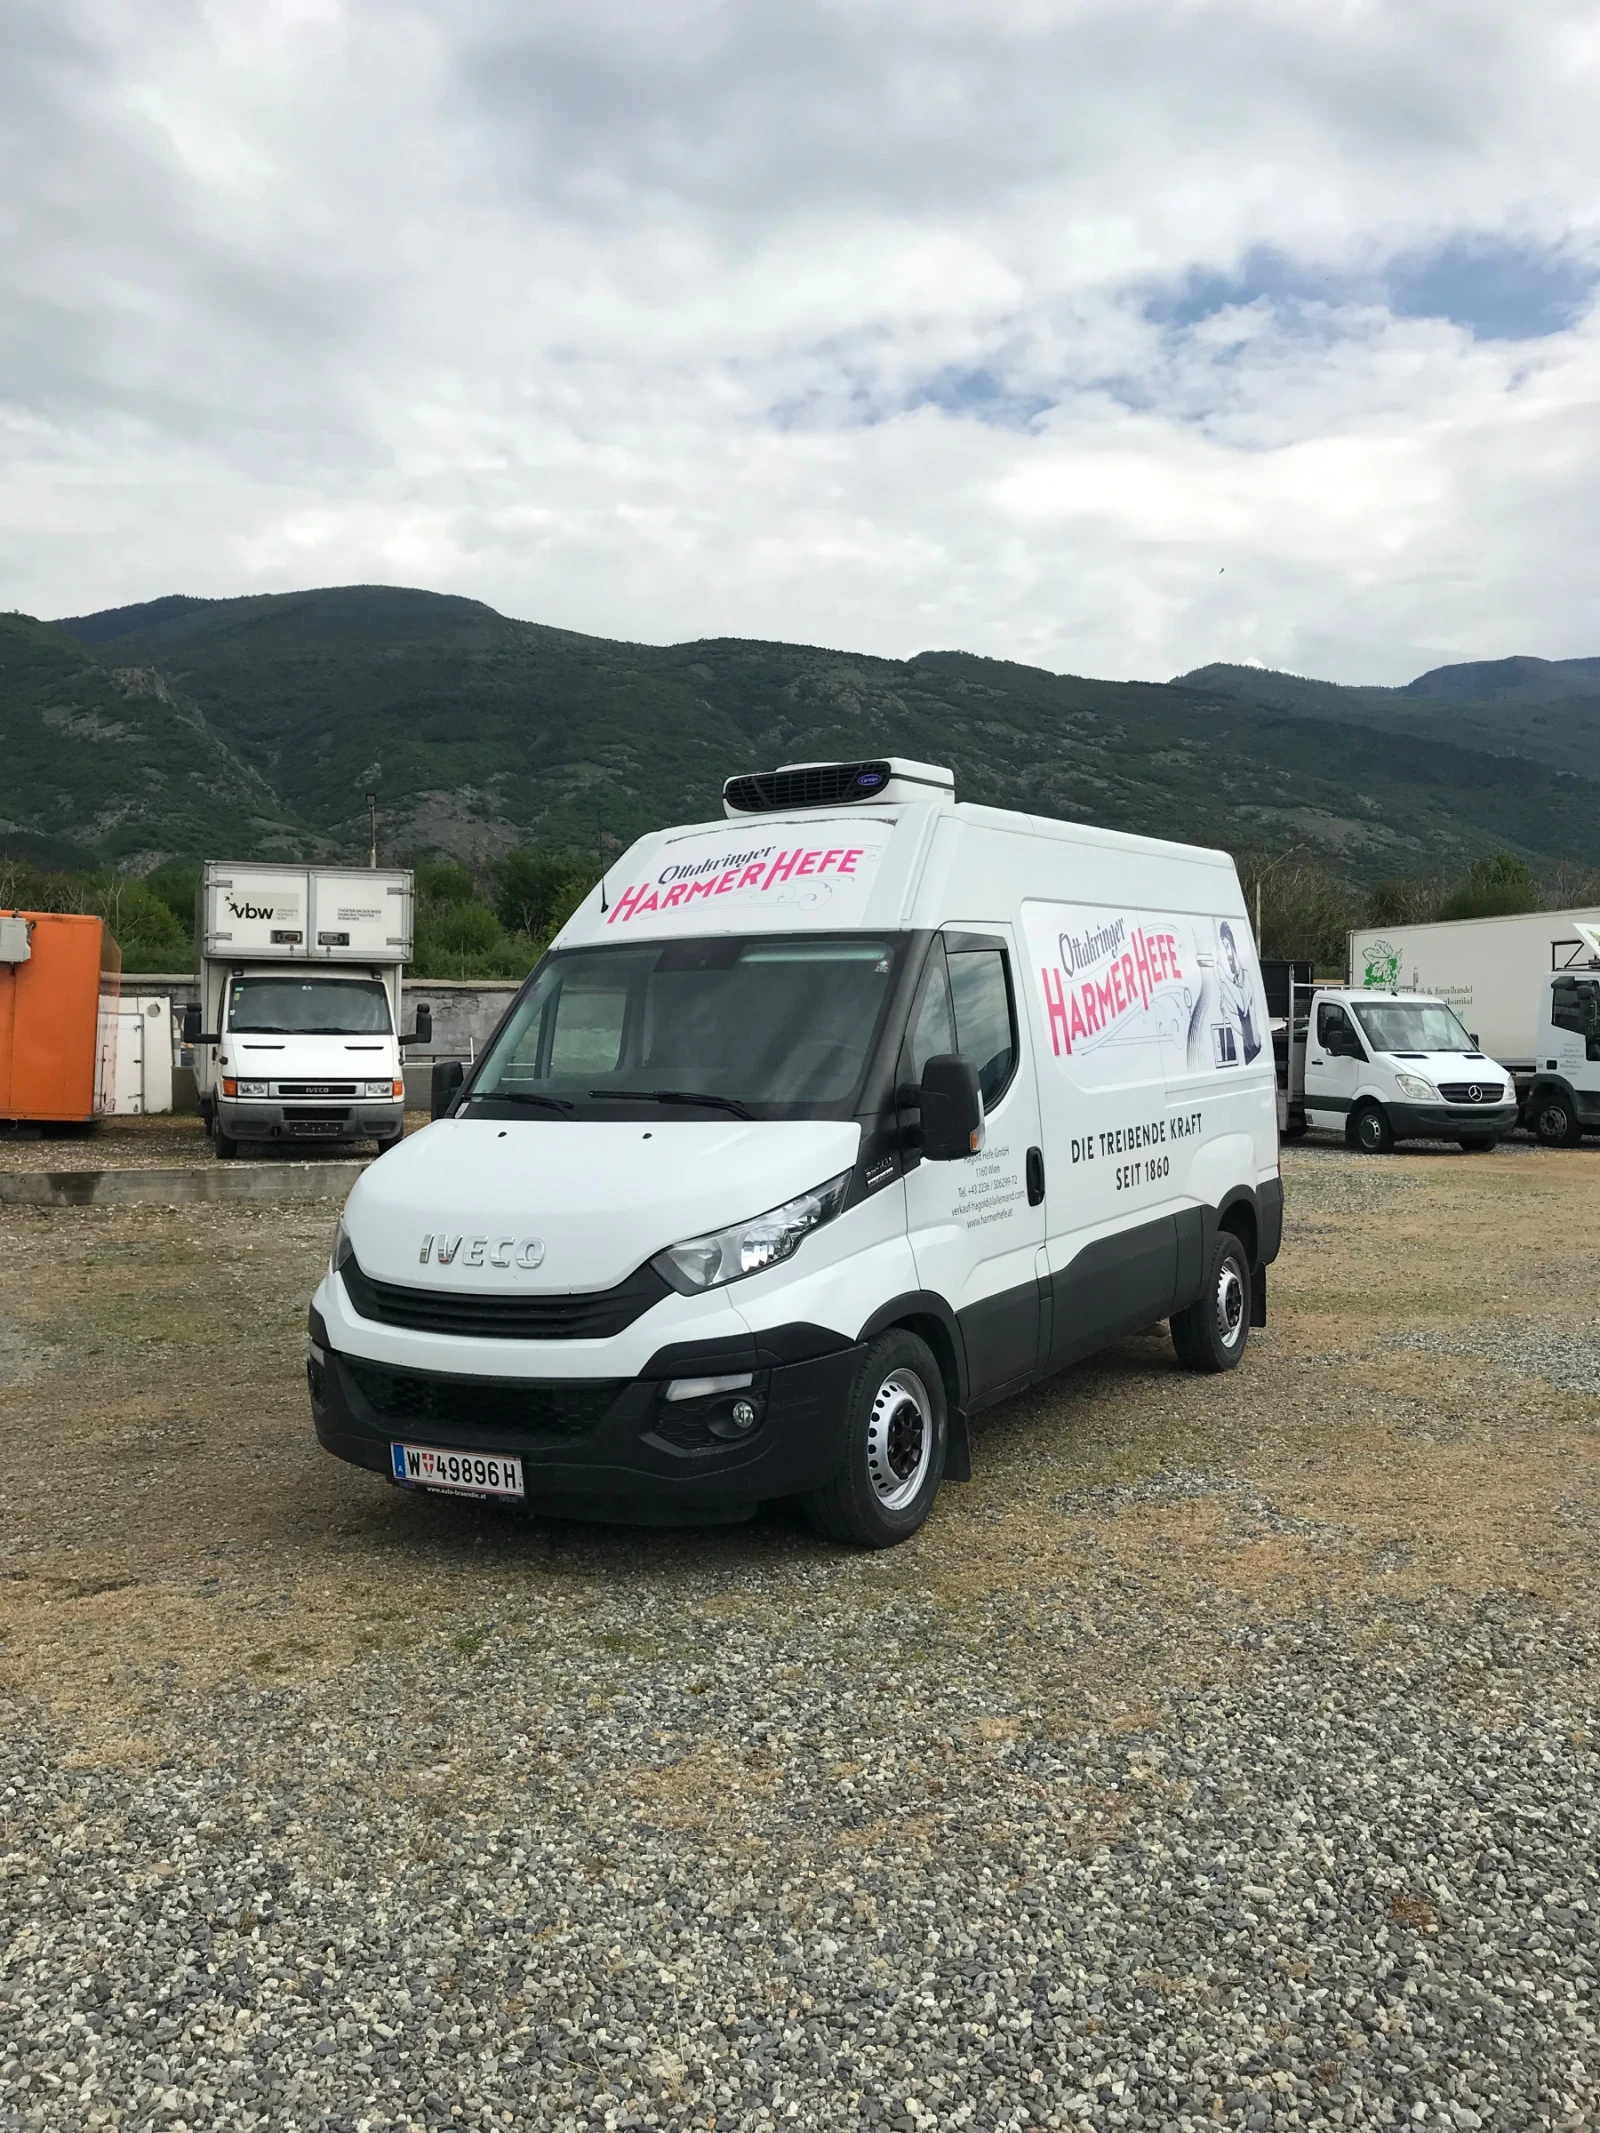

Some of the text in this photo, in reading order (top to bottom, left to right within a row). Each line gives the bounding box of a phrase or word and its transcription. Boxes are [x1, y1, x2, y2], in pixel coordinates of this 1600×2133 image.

[657, 845, 777, 885] Ottakringer
[235, 902, 275, 920] vbw
[1058, 917, 1126, 978] Ottakringer
[305, 1086, 330, 1094] IVECO
[1071, 1112, 1202, 1164] DIE TREIBENDE KRAFT
[1116, 1155, 1170, 1191] SEIT 1860
[418, 1233, 546, 1270] IVECO
[407, 1450, 420, 1477] W
